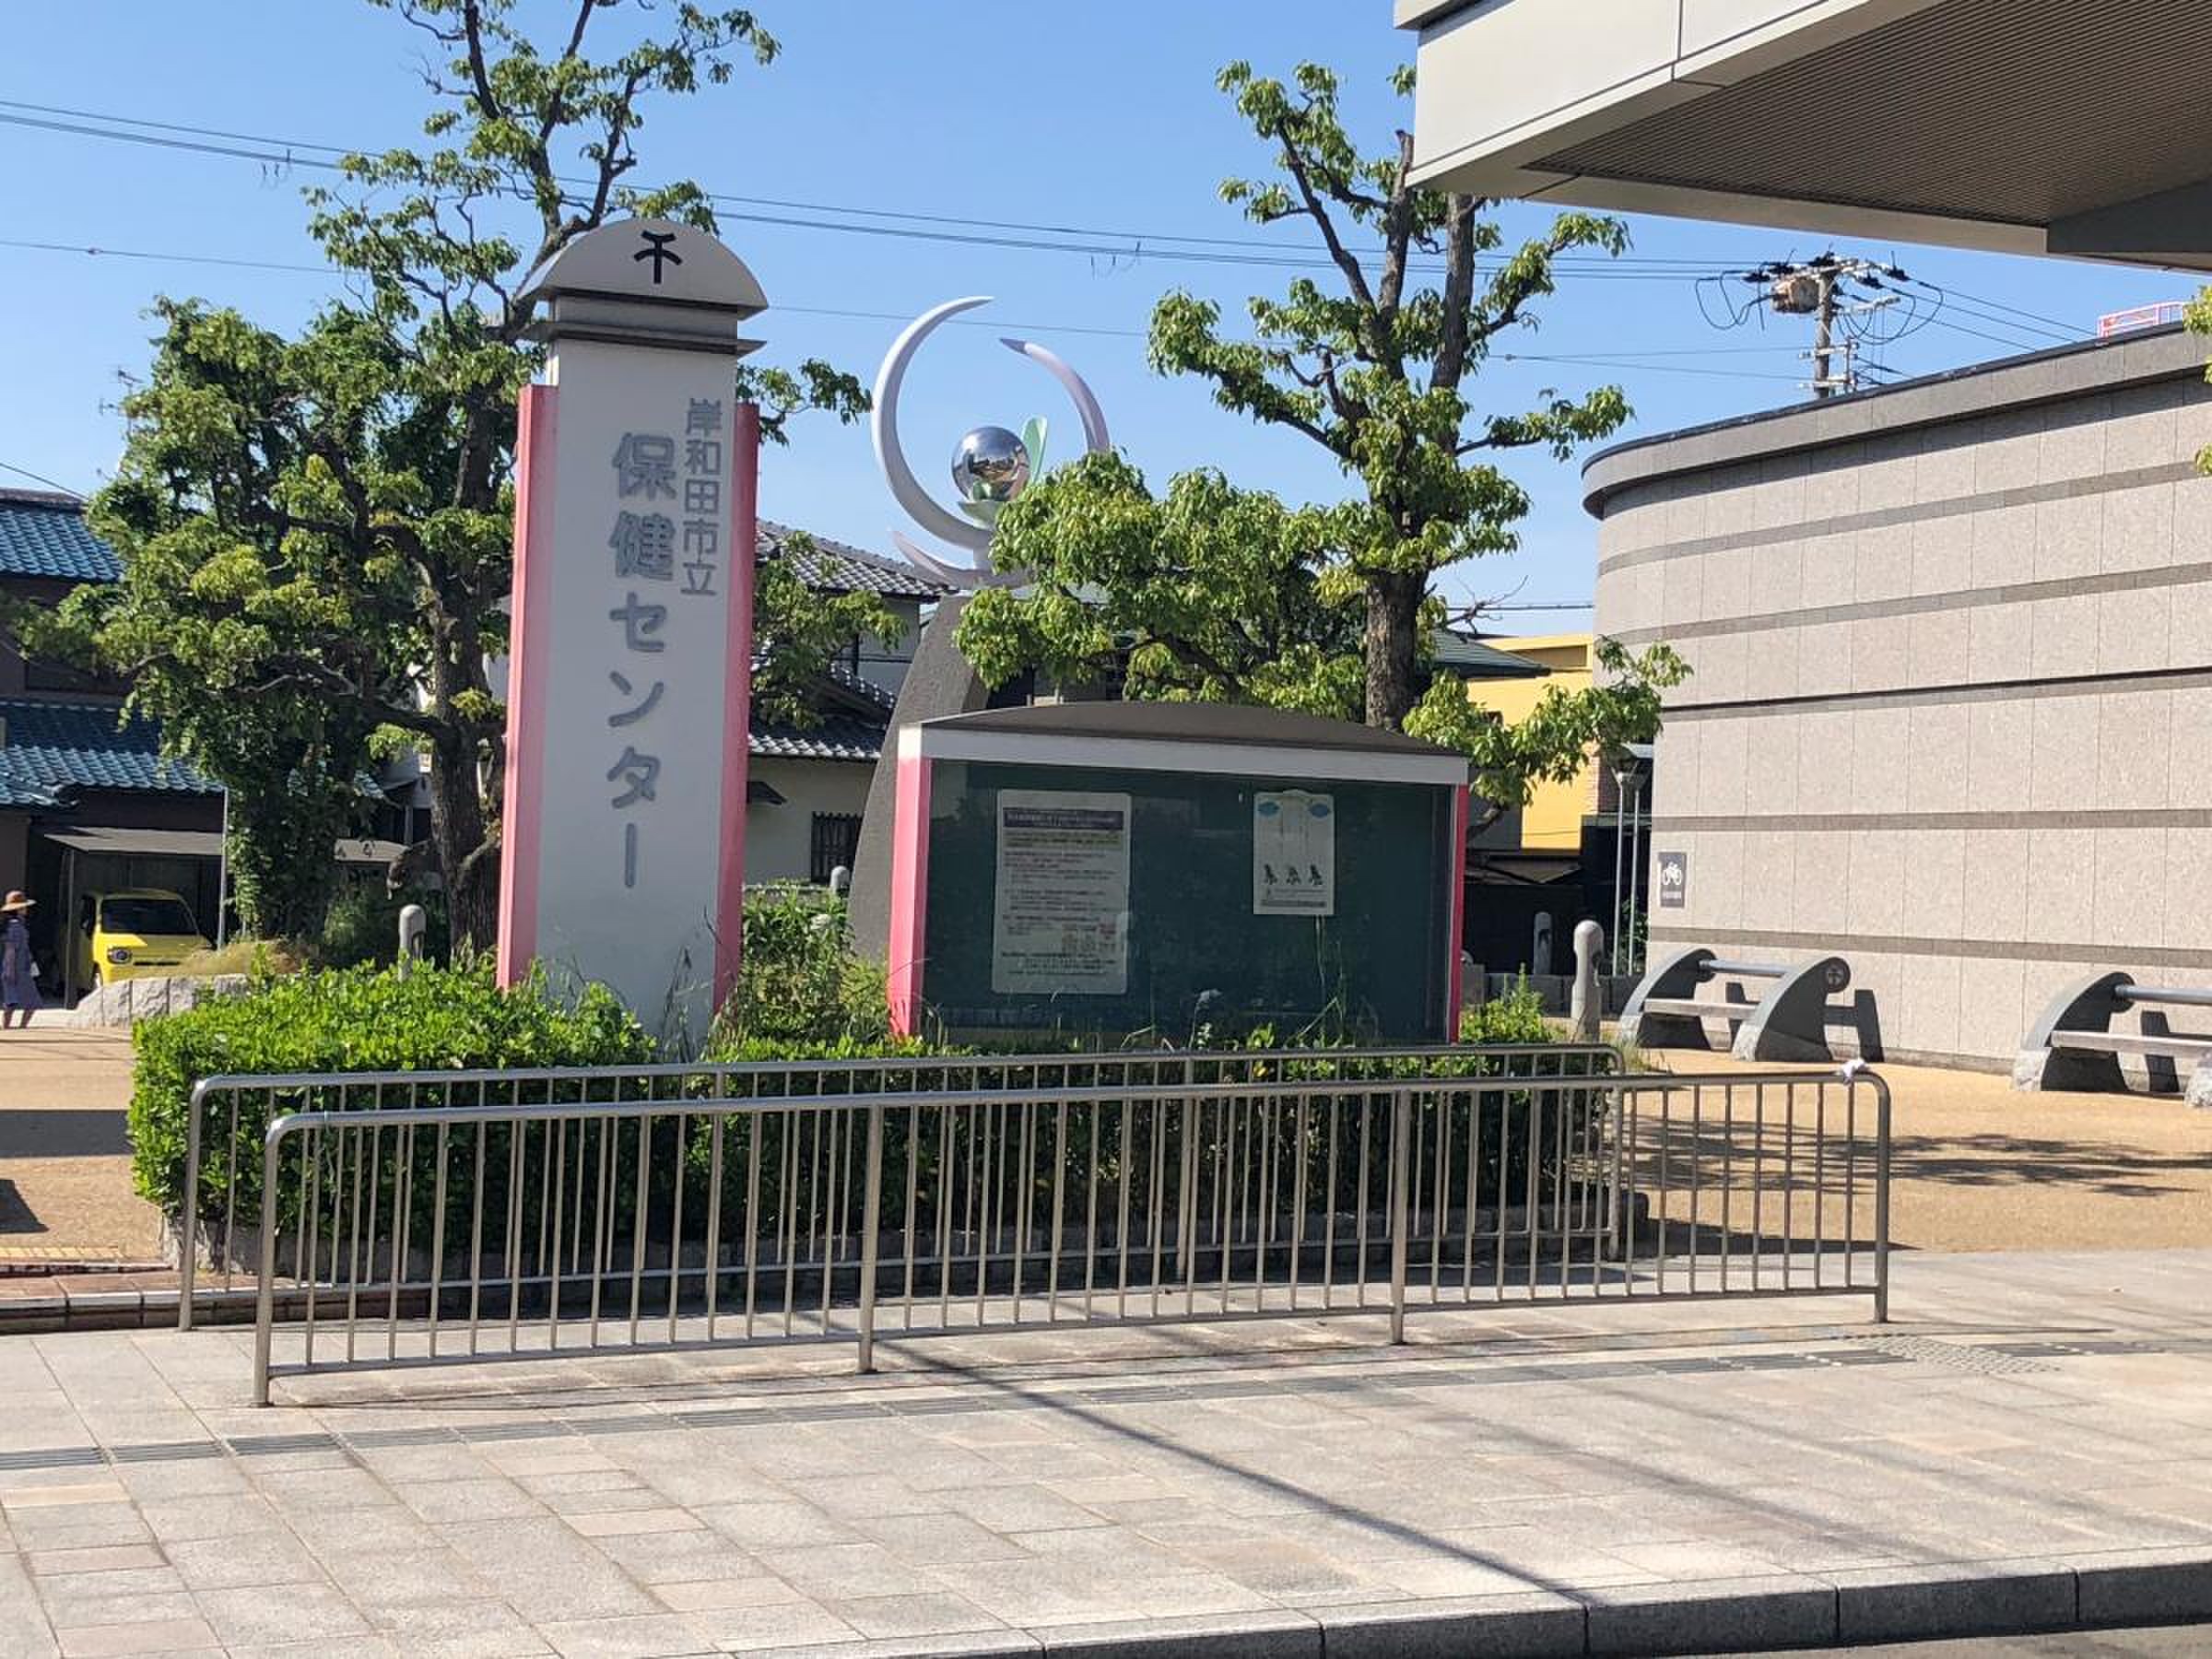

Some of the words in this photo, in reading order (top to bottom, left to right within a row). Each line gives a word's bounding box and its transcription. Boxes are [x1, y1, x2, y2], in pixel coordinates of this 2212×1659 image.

[606, 431, 677, 888] 保健センター
[681, 397, 723, 596] 岸和田市立
